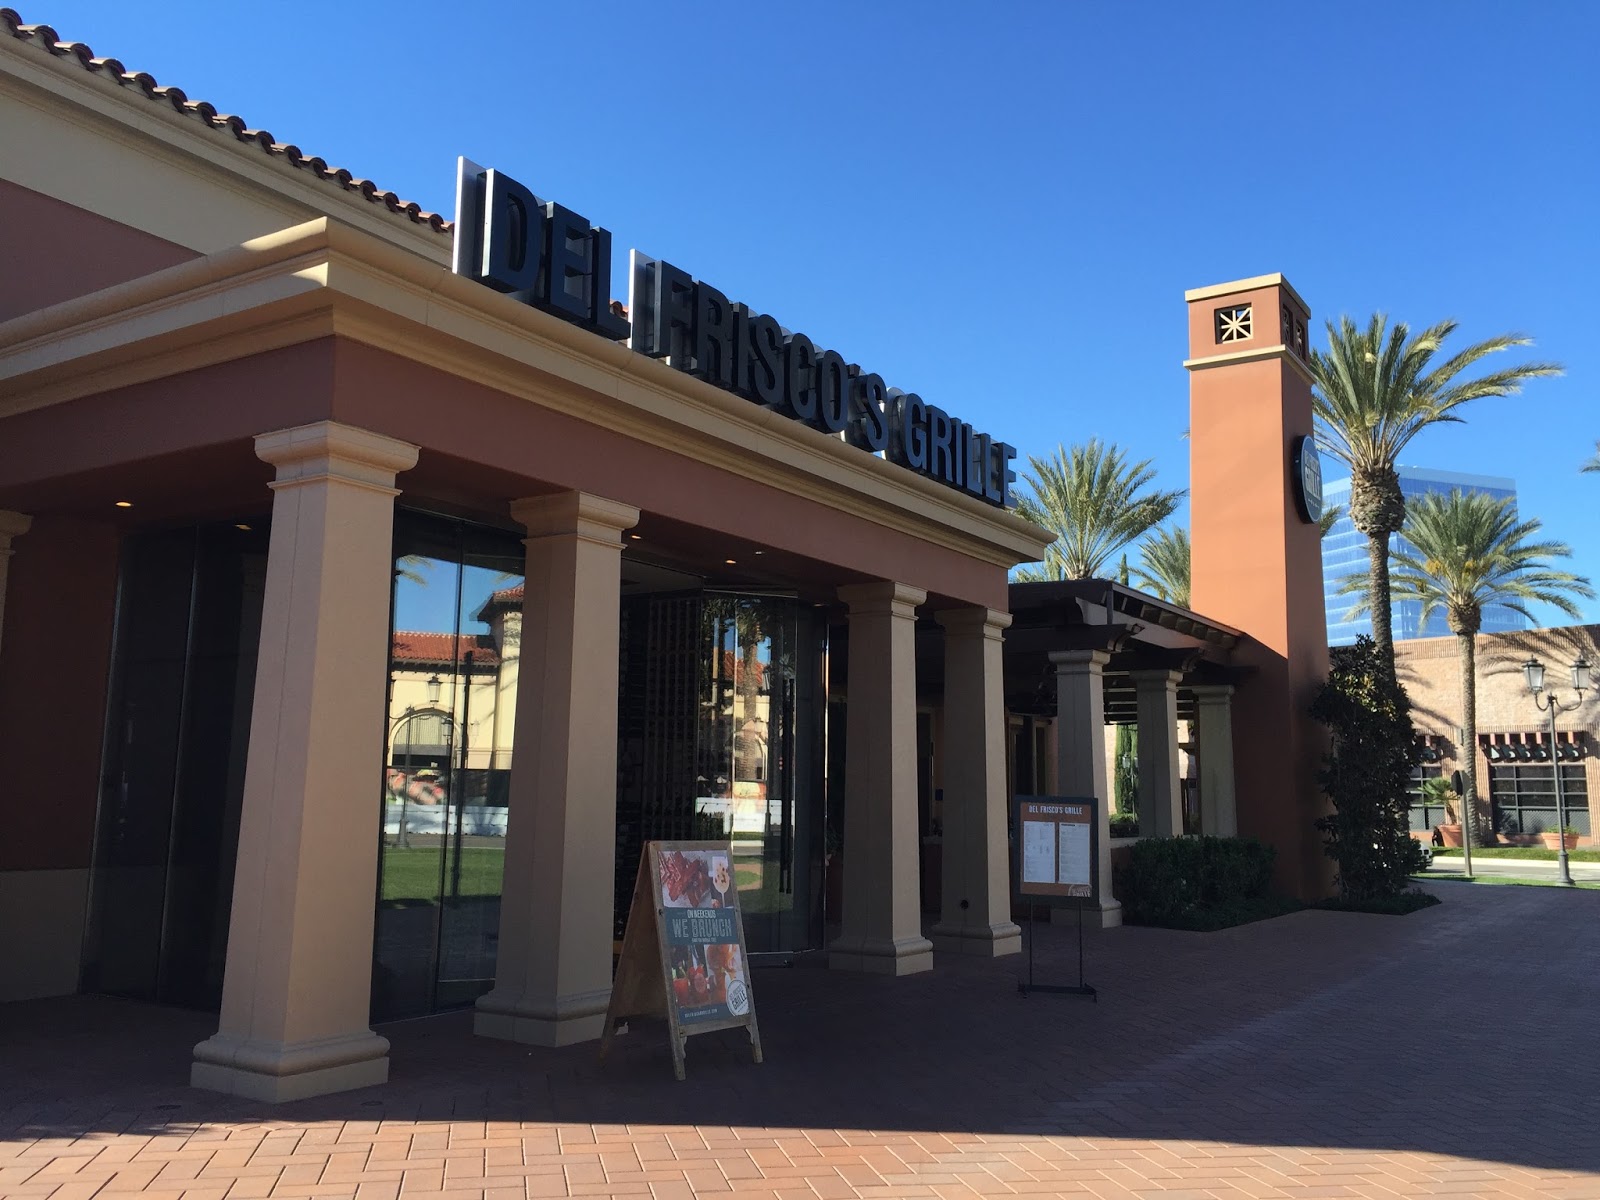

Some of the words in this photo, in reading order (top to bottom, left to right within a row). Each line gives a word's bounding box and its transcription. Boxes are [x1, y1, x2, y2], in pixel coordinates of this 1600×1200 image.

[472, 166, 631, 341] DEL
[653, 258, 889, 453] FRISCO'S
[902, 392, 1018, 508] GRILLE
[1029, 805, 1038, 813] DEL
[1040, 806, 1063, 814] FRISCO'S
[1065, 807, 1082, 815] GRILLE
[672, 919, 689, 937] WE
[691, 918, 732, 938] BRUNCH
